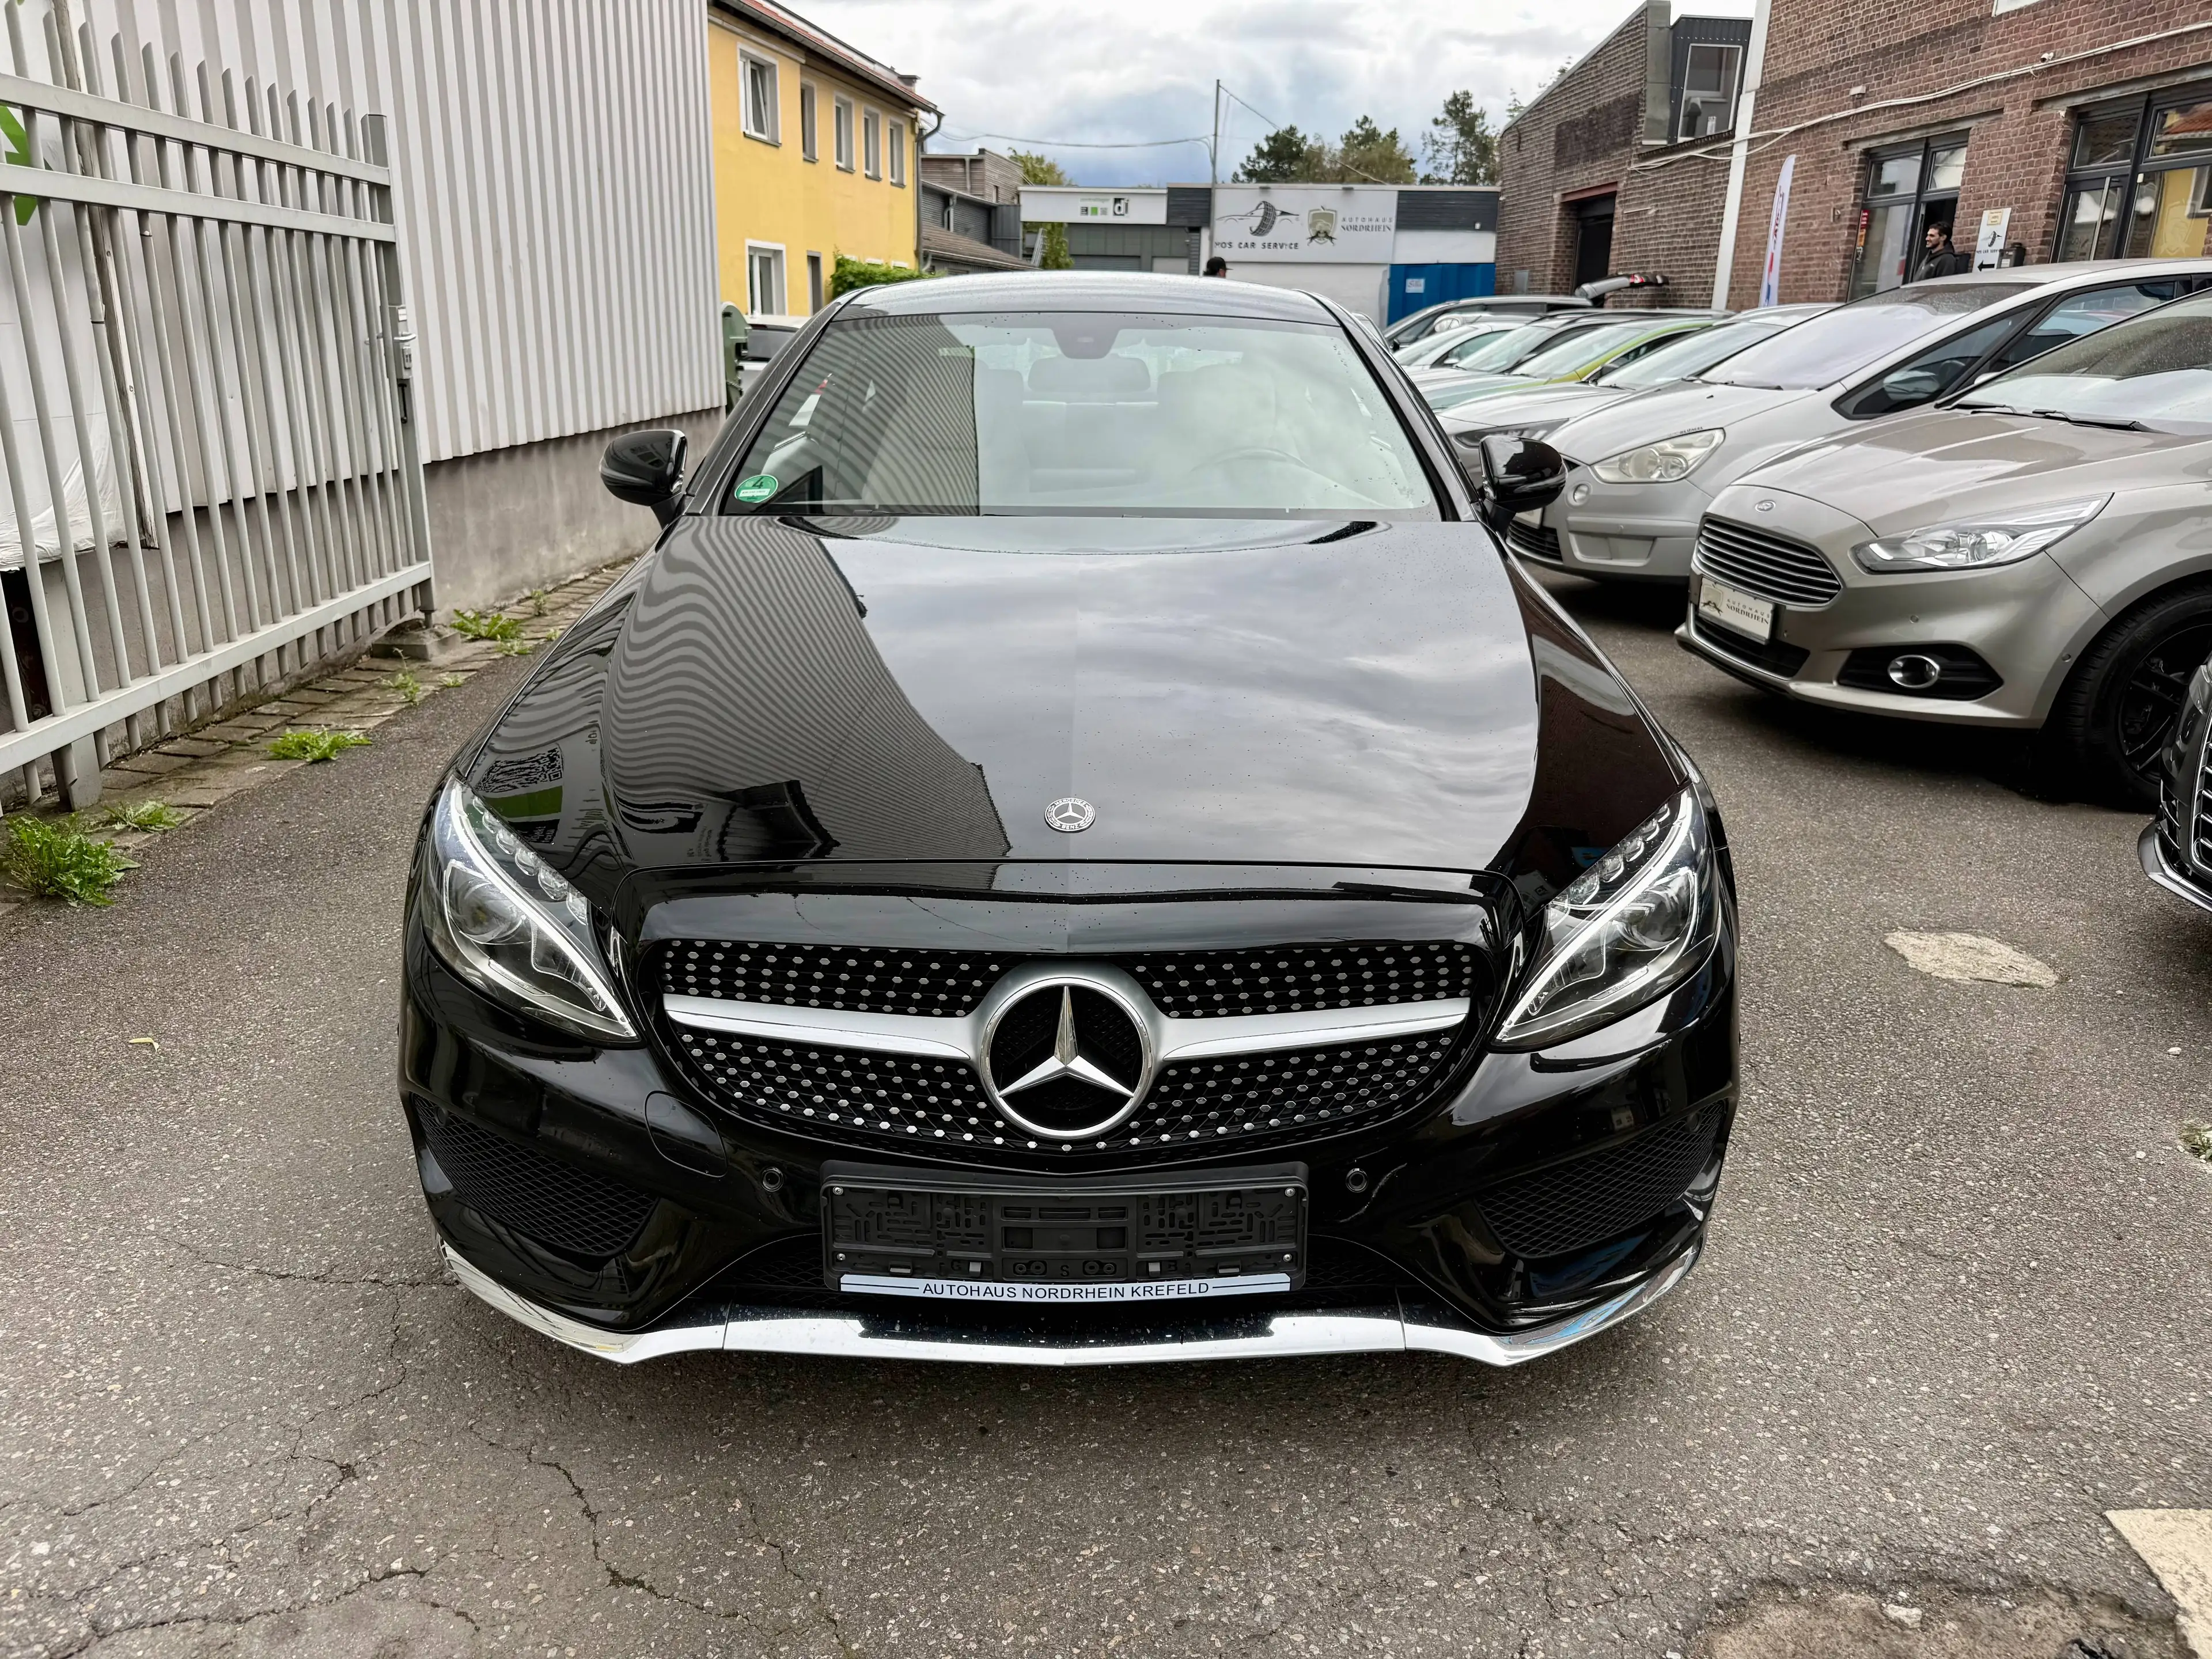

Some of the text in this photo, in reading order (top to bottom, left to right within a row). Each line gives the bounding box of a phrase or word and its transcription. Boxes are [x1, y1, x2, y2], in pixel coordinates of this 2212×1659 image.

[752, 476, 764, 488] 4
[1726, 603, 1769, 625] NORDRHEIN
[1727, 598, 1770, 618] AUTOHAUS
[923, 1283, 1209, 1299] AUTOHAUS NORDRHEIN KREFELD
